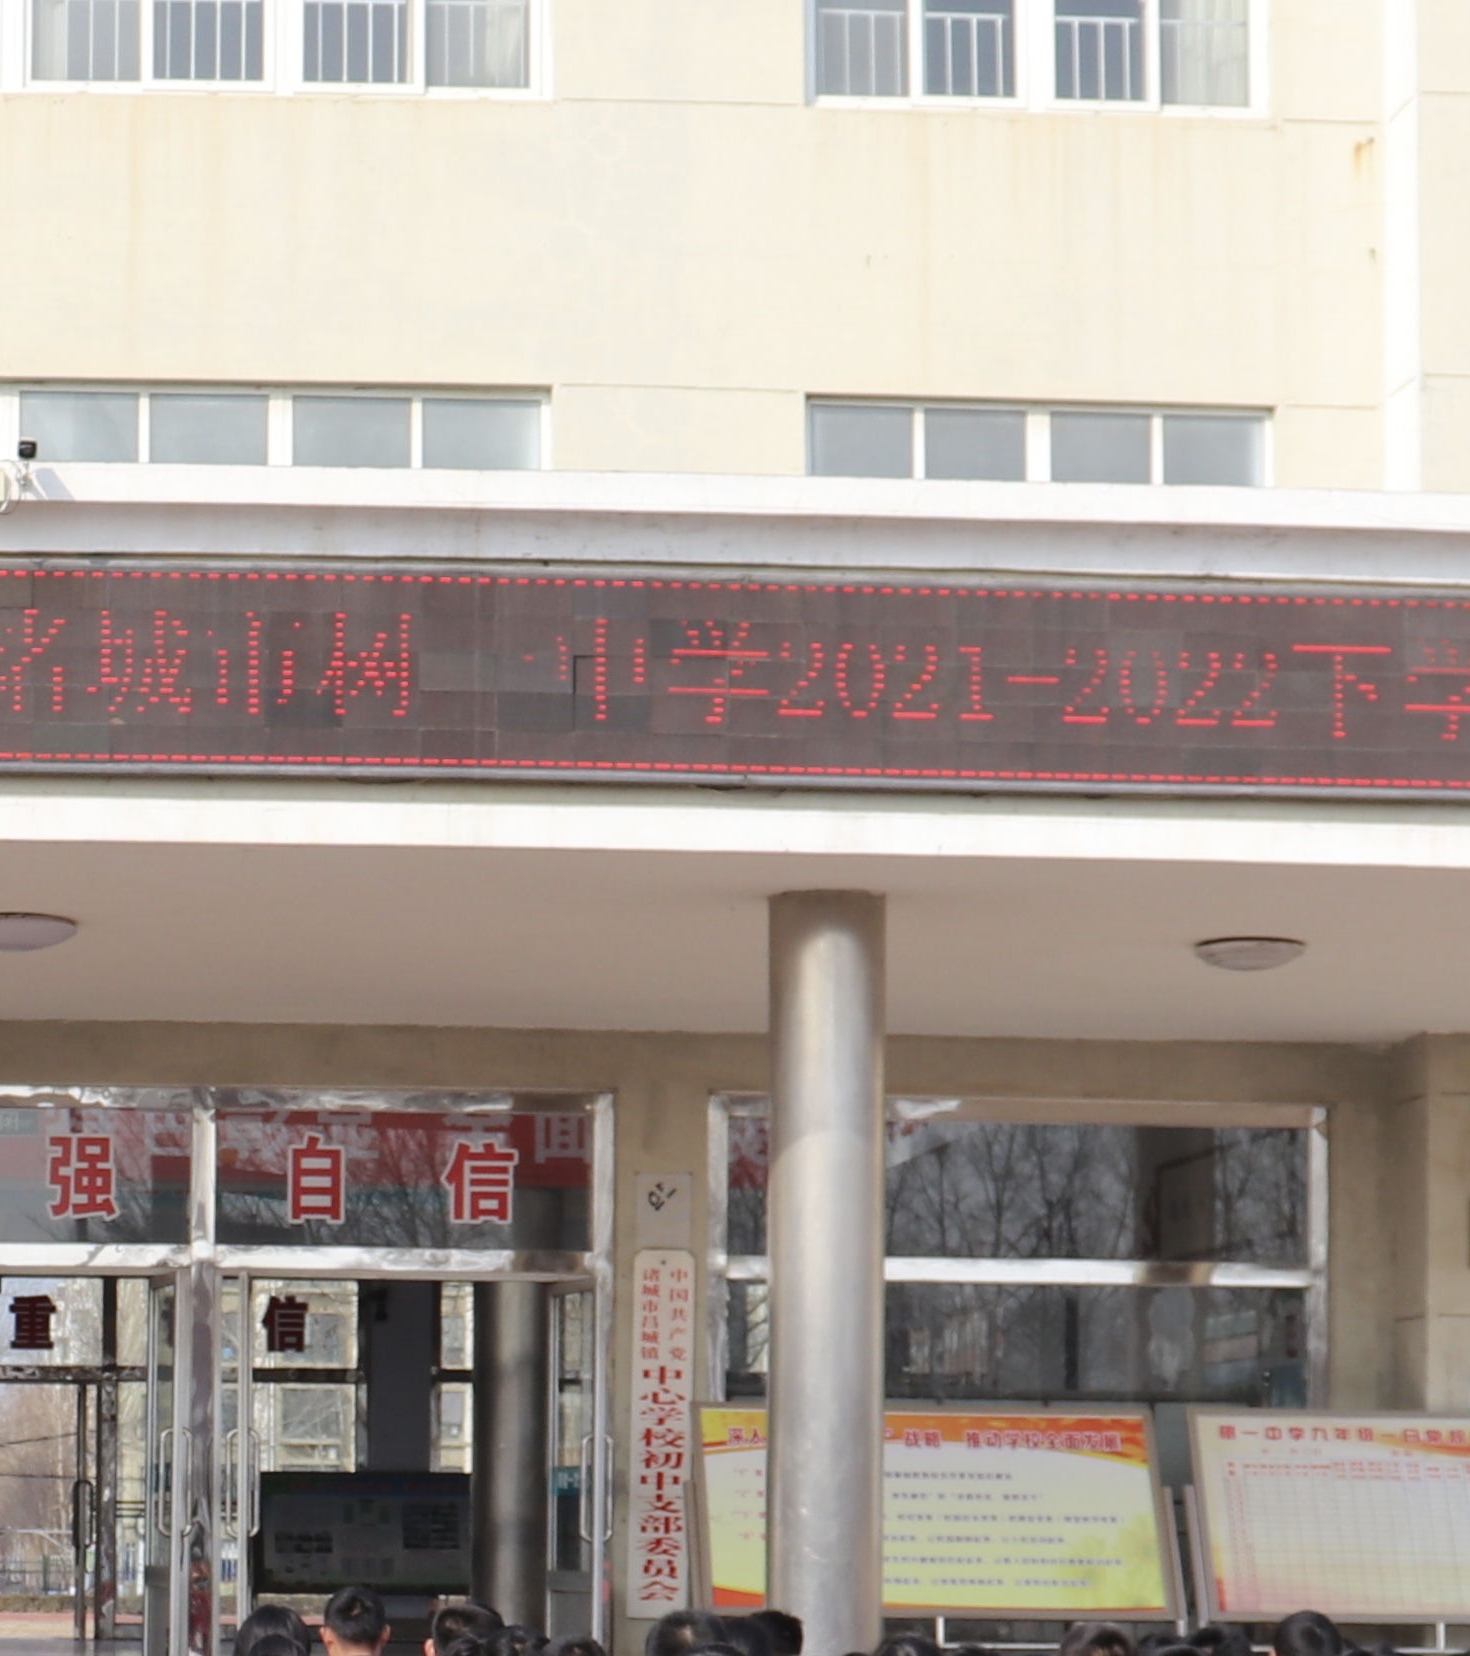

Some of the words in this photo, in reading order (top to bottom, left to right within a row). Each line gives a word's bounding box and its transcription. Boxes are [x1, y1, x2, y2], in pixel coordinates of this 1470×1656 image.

[286, 1130, 519, 1226] 自信
[669, 1267, 689, 1361] 中国共产党
[638, 1365, 687, 1602] 中心学校初中支部委员会
